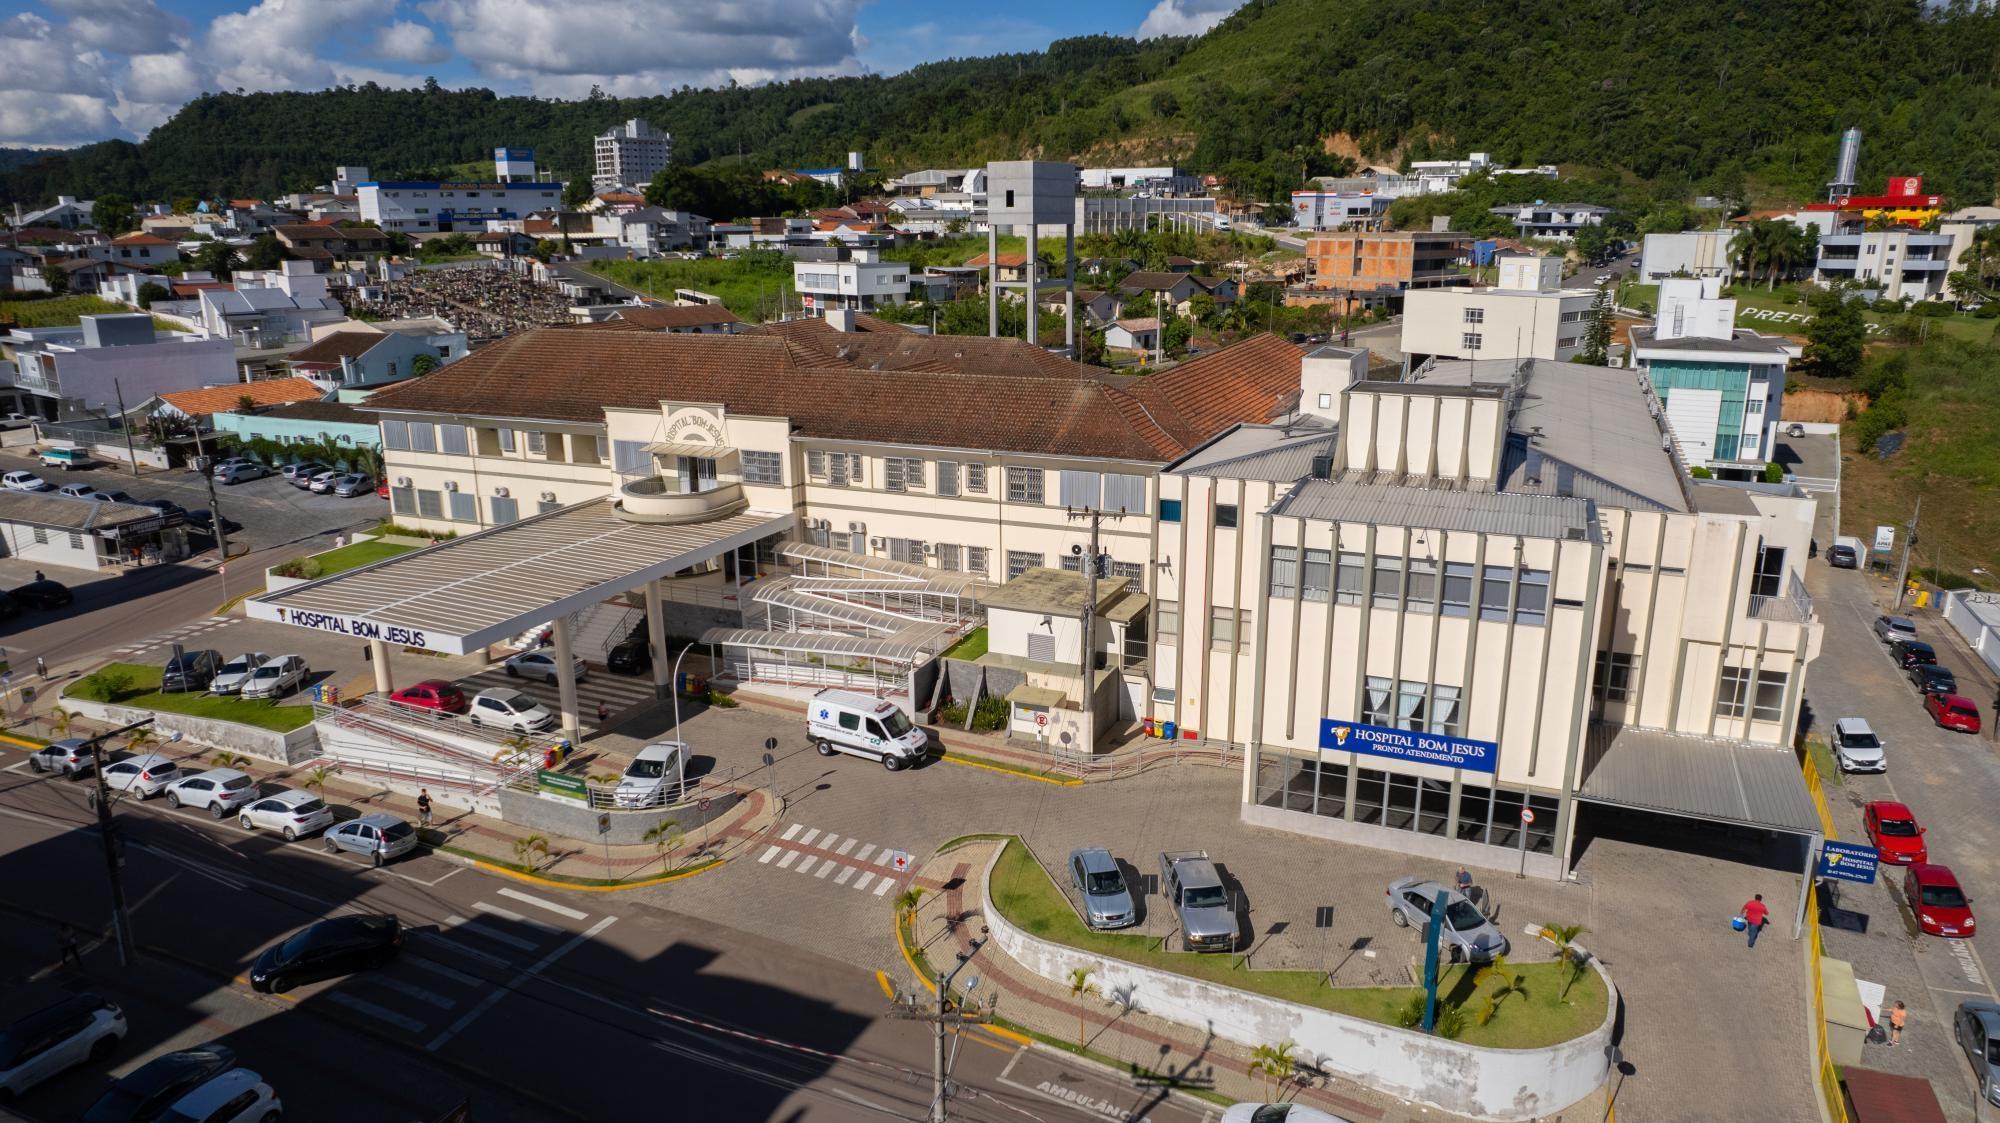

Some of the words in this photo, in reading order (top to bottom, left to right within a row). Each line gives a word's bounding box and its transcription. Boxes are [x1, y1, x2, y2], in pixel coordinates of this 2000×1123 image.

[665, 416, 690, 443] HOSPITAL
[290, 609, 349, 634] HOSPITAL
[351, 620, 380, 639] BOM
[384, 626, 426, 647] JESUS
[1355, 728, 1414, 747] HOSPITAL
[1418, 738, 1448, 752] BOM
[1450, 743, 1485, 758] JESUS
[1372, 743, 1404, 755] PRONTO
[1405, 749, 1464, 764] ATENDIMENTO
[1856, 863, 1875, 871] JESUS
[1950, 940, 1985, 985] AMBULÂNC
[1036, 1081, 1152, 1122] AMBULÂNC
